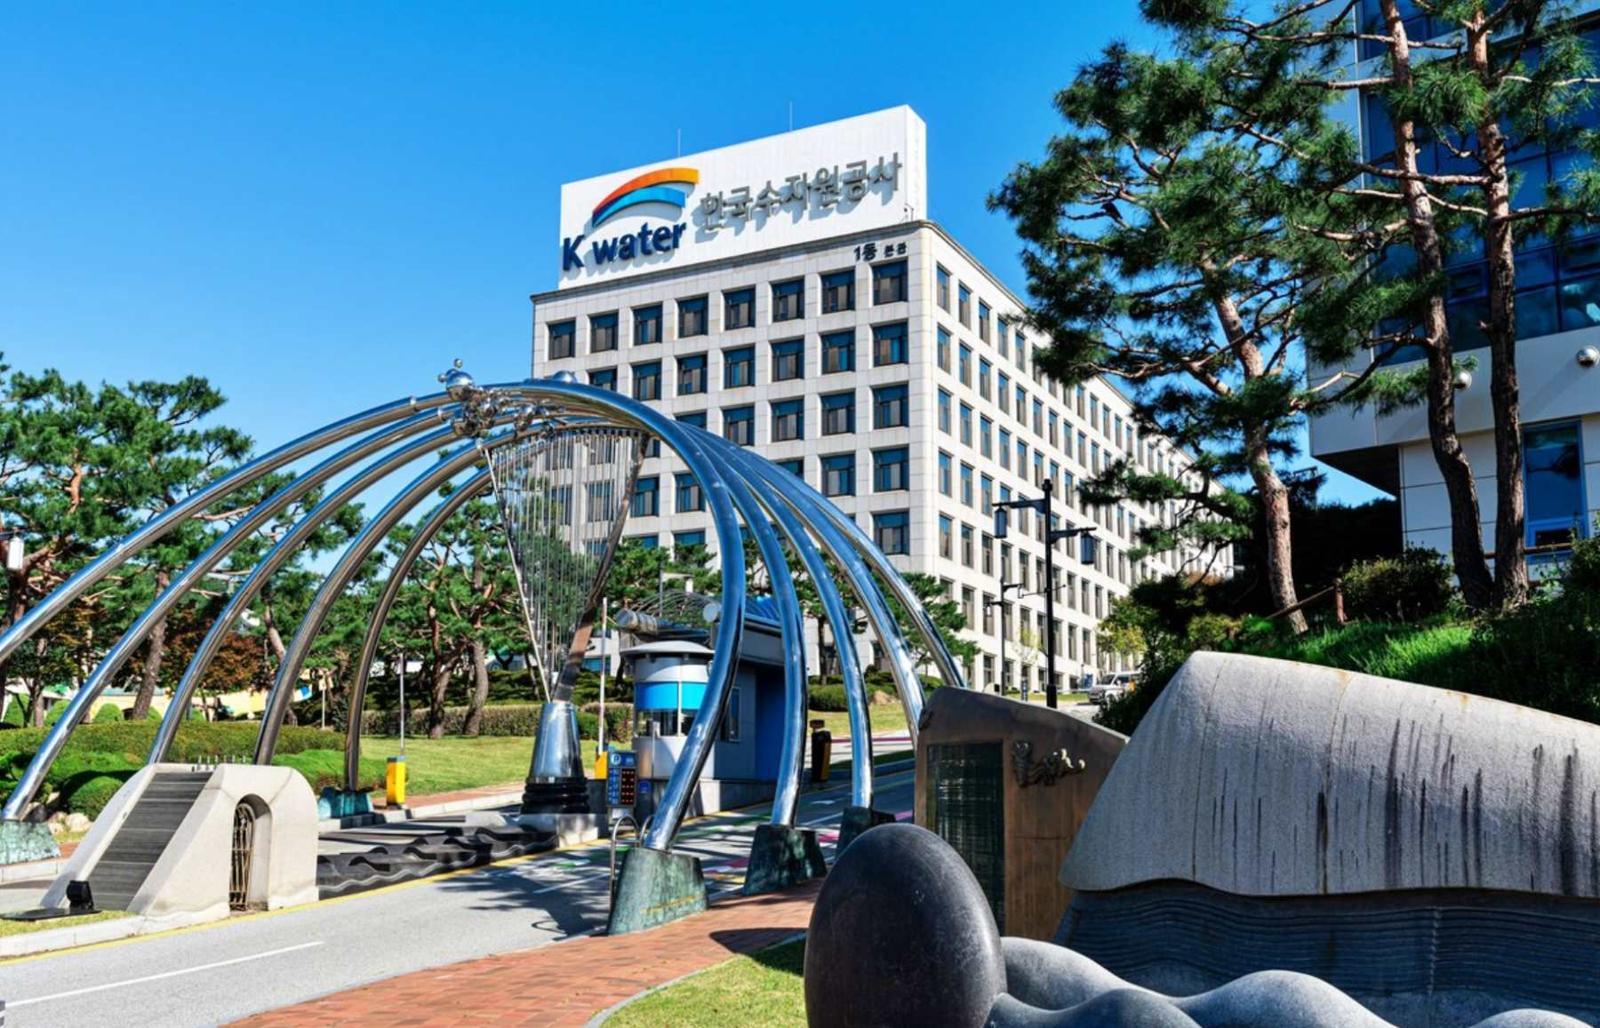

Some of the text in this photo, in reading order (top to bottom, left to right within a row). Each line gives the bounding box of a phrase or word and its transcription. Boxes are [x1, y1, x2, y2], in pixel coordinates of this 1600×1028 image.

[700, 152, 903, 231] 한국수자원공사
[562, 222, 687, 271] K water
